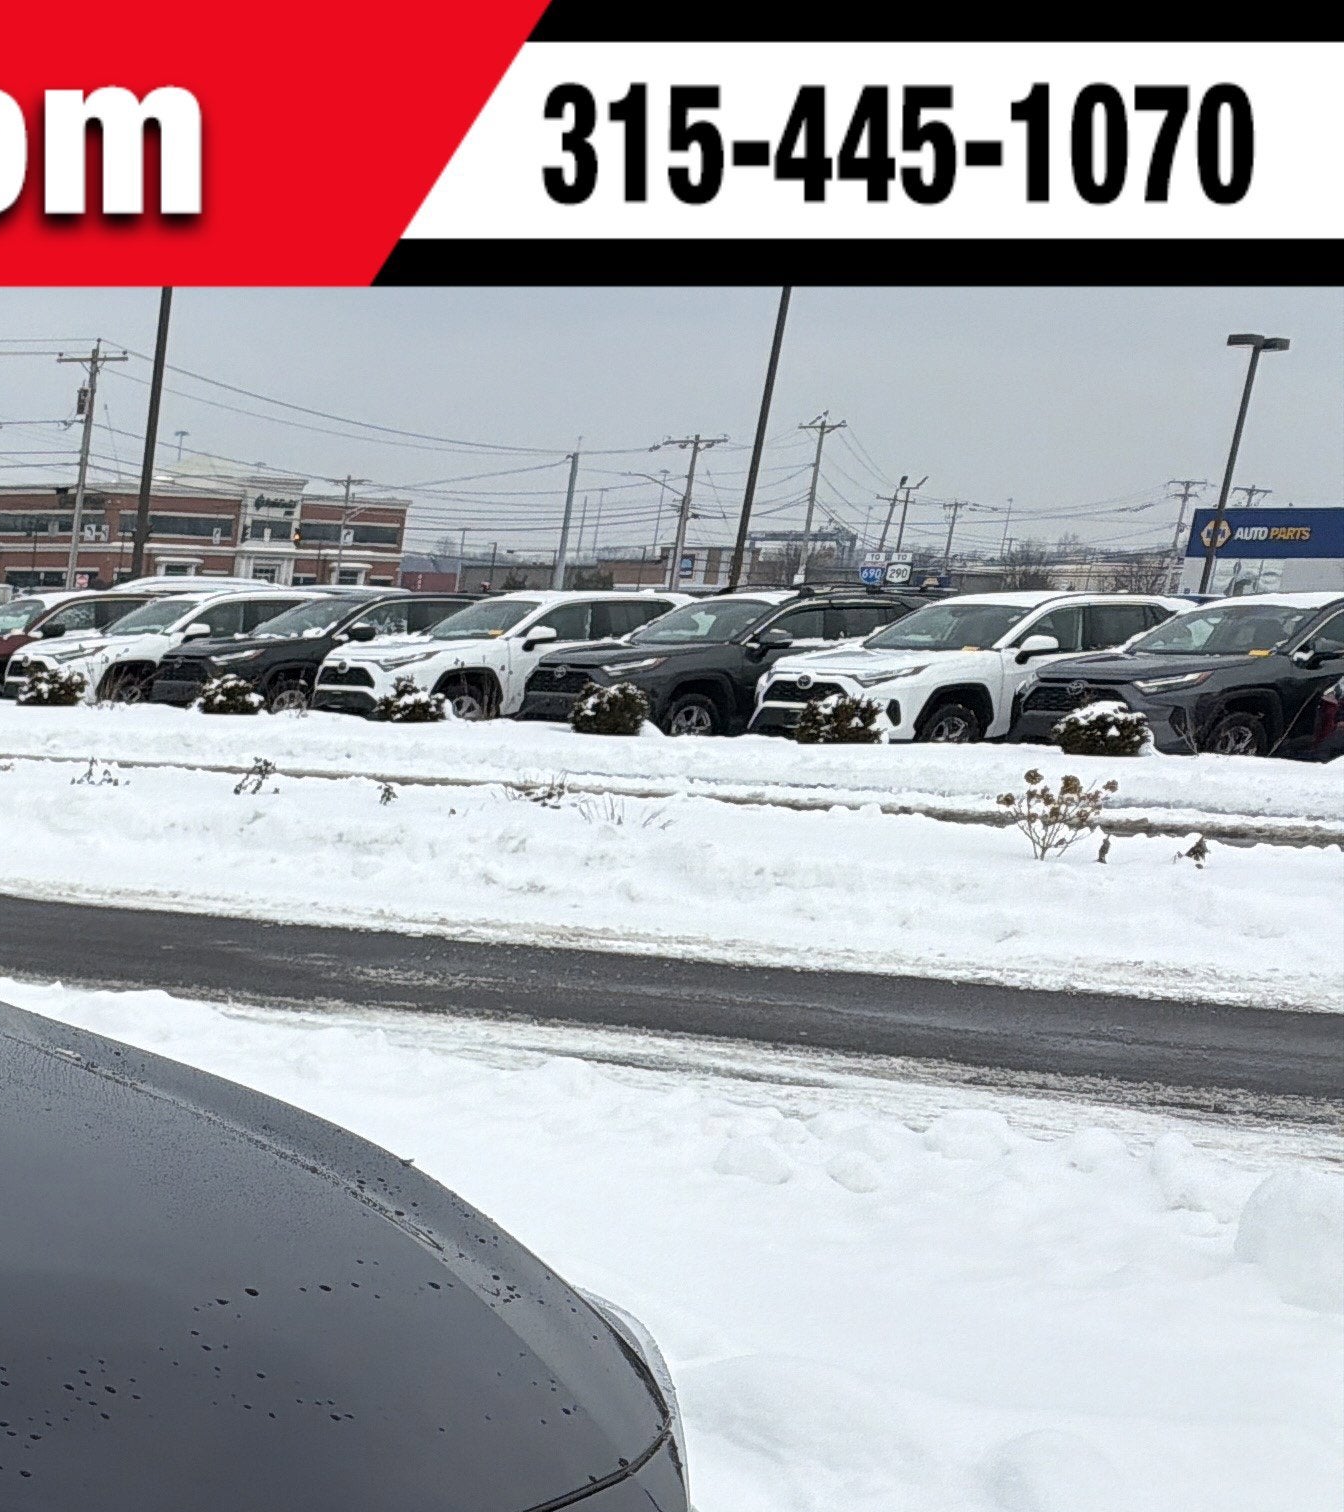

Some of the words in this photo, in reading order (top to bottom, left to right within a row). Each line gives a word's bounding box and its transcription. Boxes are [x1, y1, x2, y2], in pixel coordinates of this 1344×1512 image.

[1233, 526, 1269, 541] AUTO
[1269, 526, 1311, 541] PARTS
[862, 568, 882, 579] 690
[888, 568, 908, 579] 290
